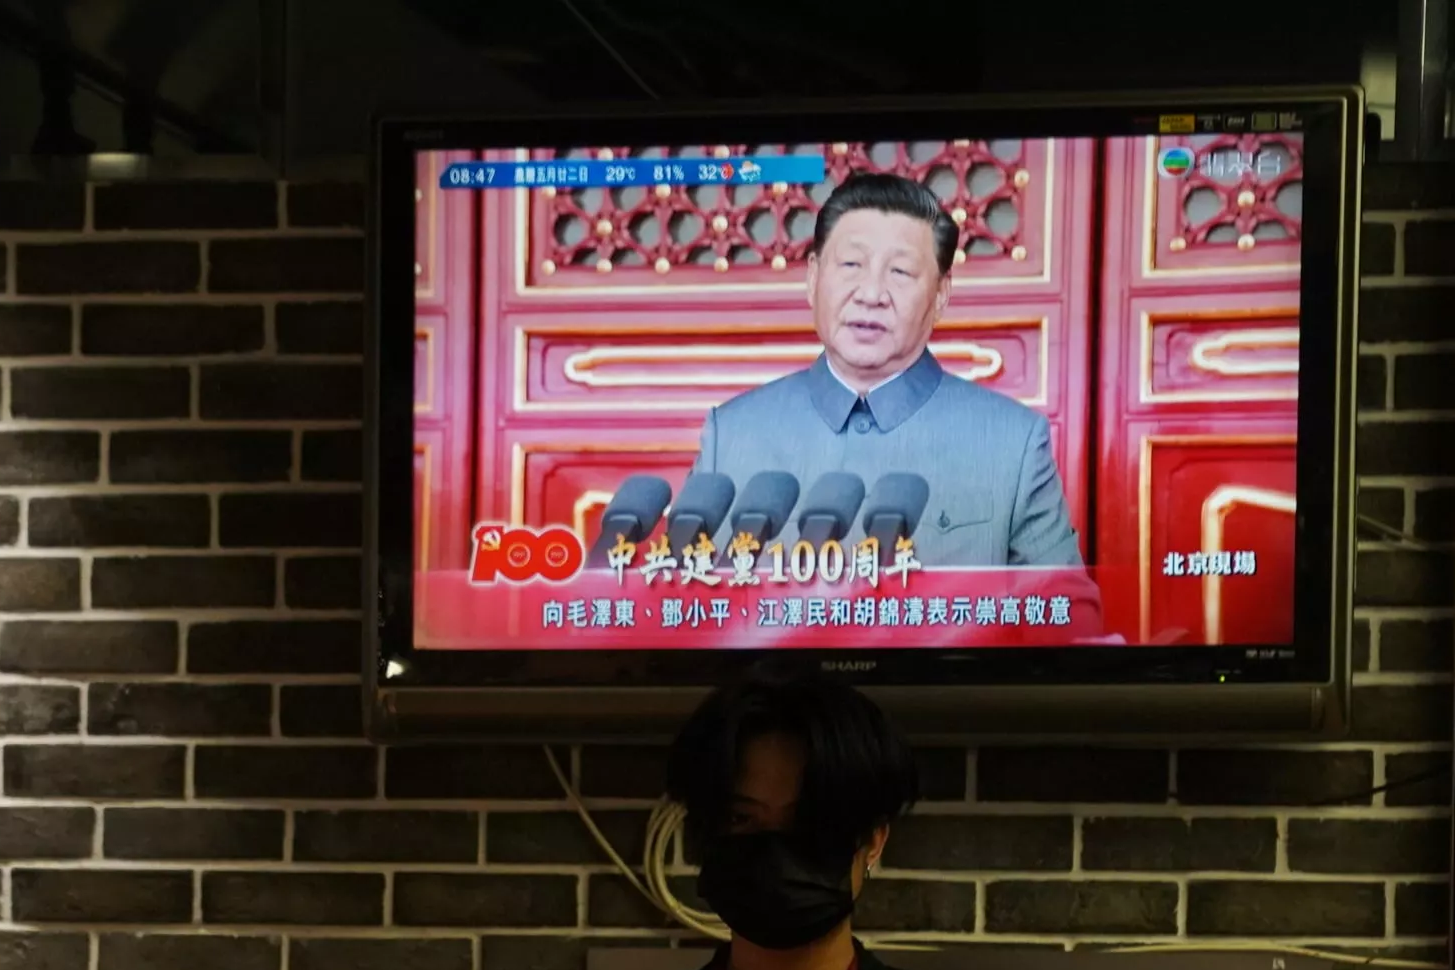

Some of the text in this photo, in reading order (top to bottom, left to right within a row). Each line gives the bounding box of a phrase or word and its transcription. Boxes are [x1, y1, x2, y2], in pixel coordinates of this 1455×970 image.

[449, 168, 496, 184] 08:47
[653, 164, 685, 181] 81%
[607, 532, 922, 588] 中共建黨100周年
[1163, 551, 1256, 576] 北京現場
[820, 660, 878, 672] SHARP
